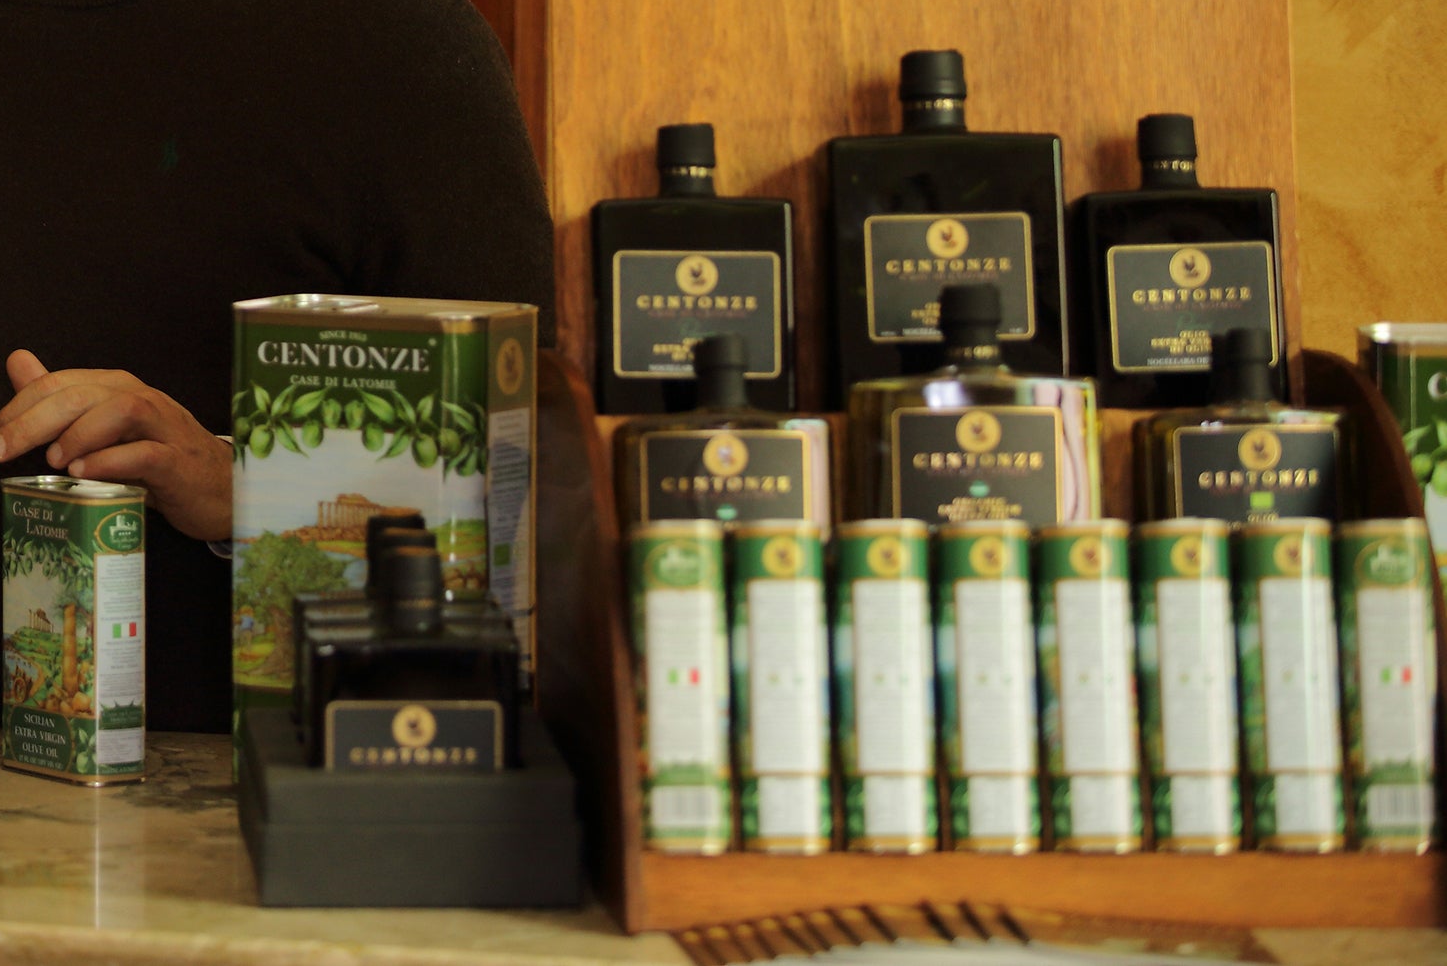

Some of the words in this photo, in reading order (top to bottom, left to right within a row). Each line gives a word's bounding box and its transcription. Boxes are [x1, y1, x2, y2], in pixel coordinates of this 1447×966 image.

[885, 257, 1013, 274] CENTONZE
[636, 294, 758, 311] CENTONZE
[1132, 286, 1251, 304] CENTONZE
[257, 340, 430, 372] CENTONZE
[290, 374, 320, 385] CASE
[325, 376, 338, 387] DI
[342, 377, 396, 390] LATOMIE
[12, 501, 40, 520] CASE
[43, 510, 53, 522] DI
[26, 518, 68, 540] LATOMIE
[24, 714, 55, 728] SICILIAN
[14, 725, 37, 740] EXTRA
[39, 731, 66, 745] VIRGIN
[22, 742, 44, 755] OLIVE
[46, 747, 59, 758] OIL
